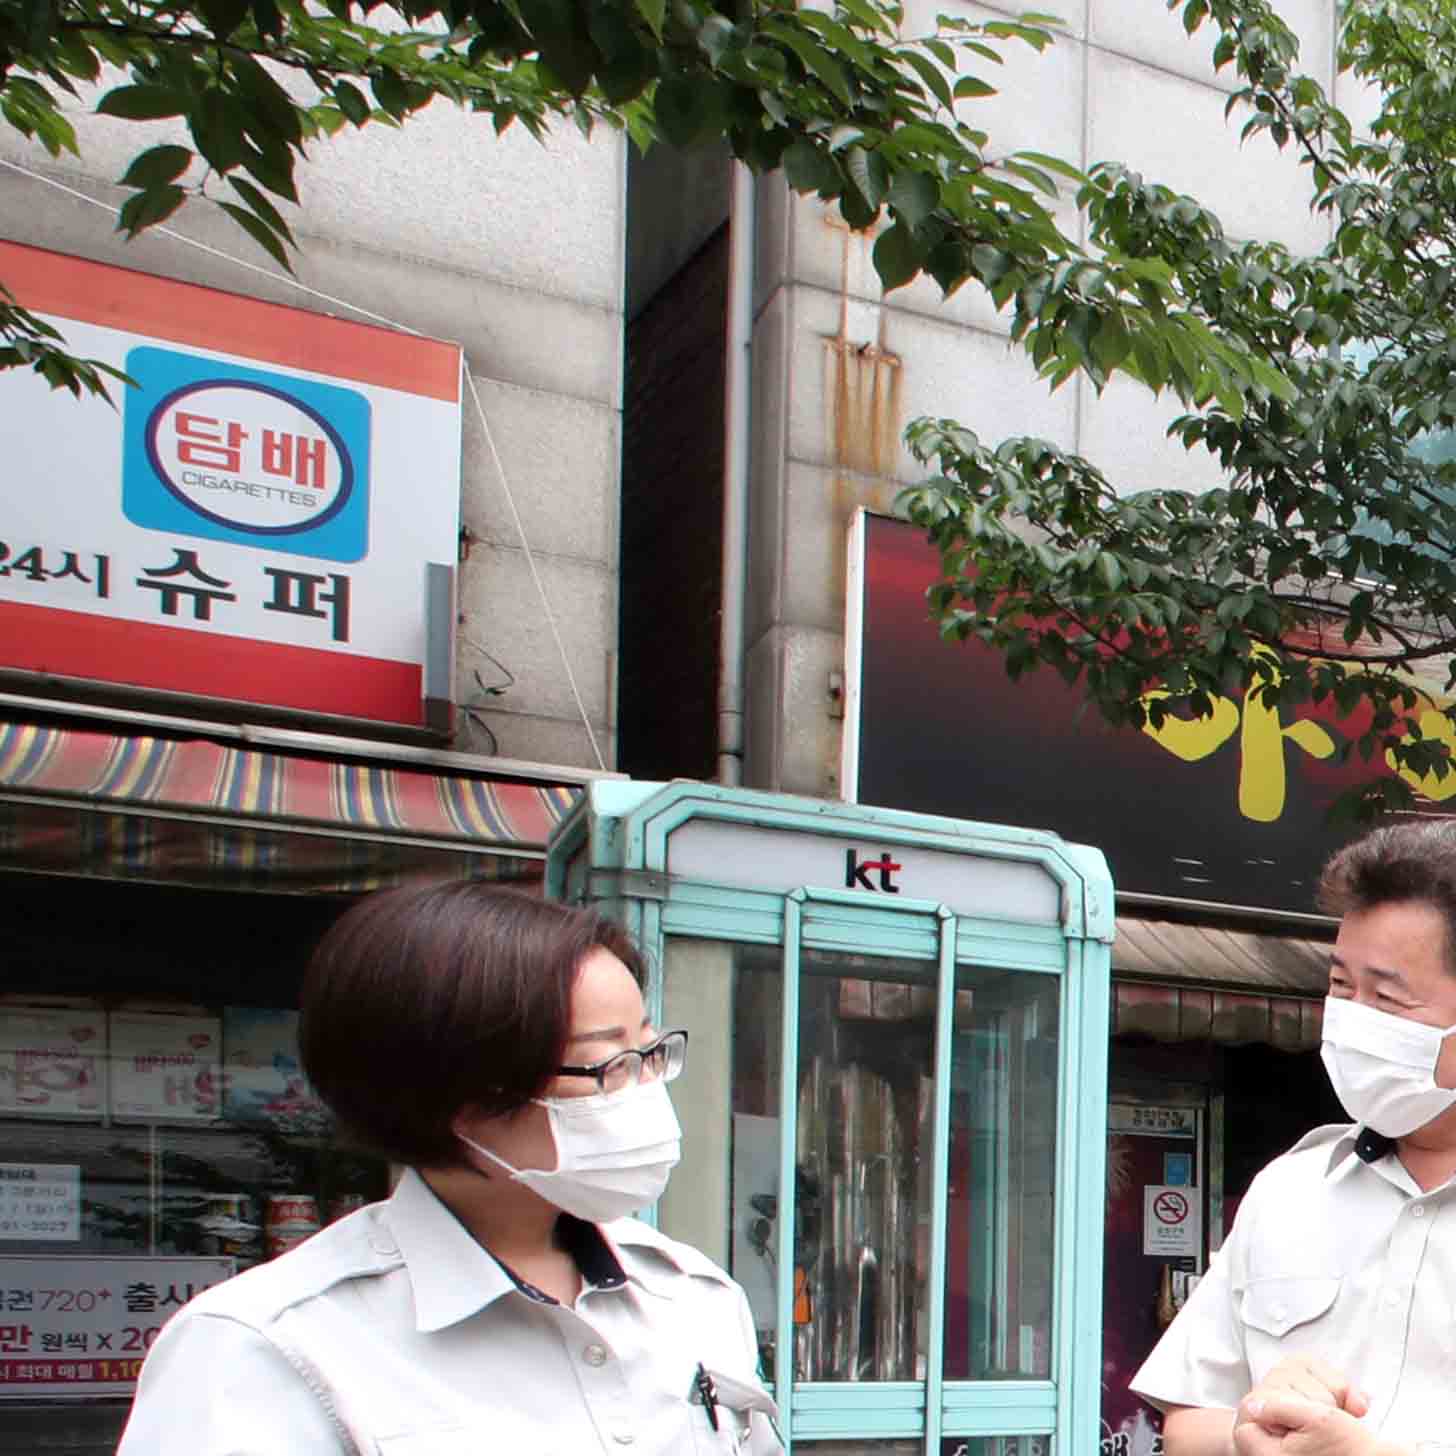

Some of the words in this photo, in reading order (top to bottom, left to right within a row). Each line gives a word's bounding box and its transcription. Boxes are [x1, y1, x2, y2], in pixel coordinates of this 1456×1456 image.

[175, 410, 327, 490] 담배
[181, 469, 318, 508] CIGARETTES
[136, 547, 352, 643] 슈퍼
[845, 847, 903, 894] kt
[40, 1331, 88, 1353] 원씩
